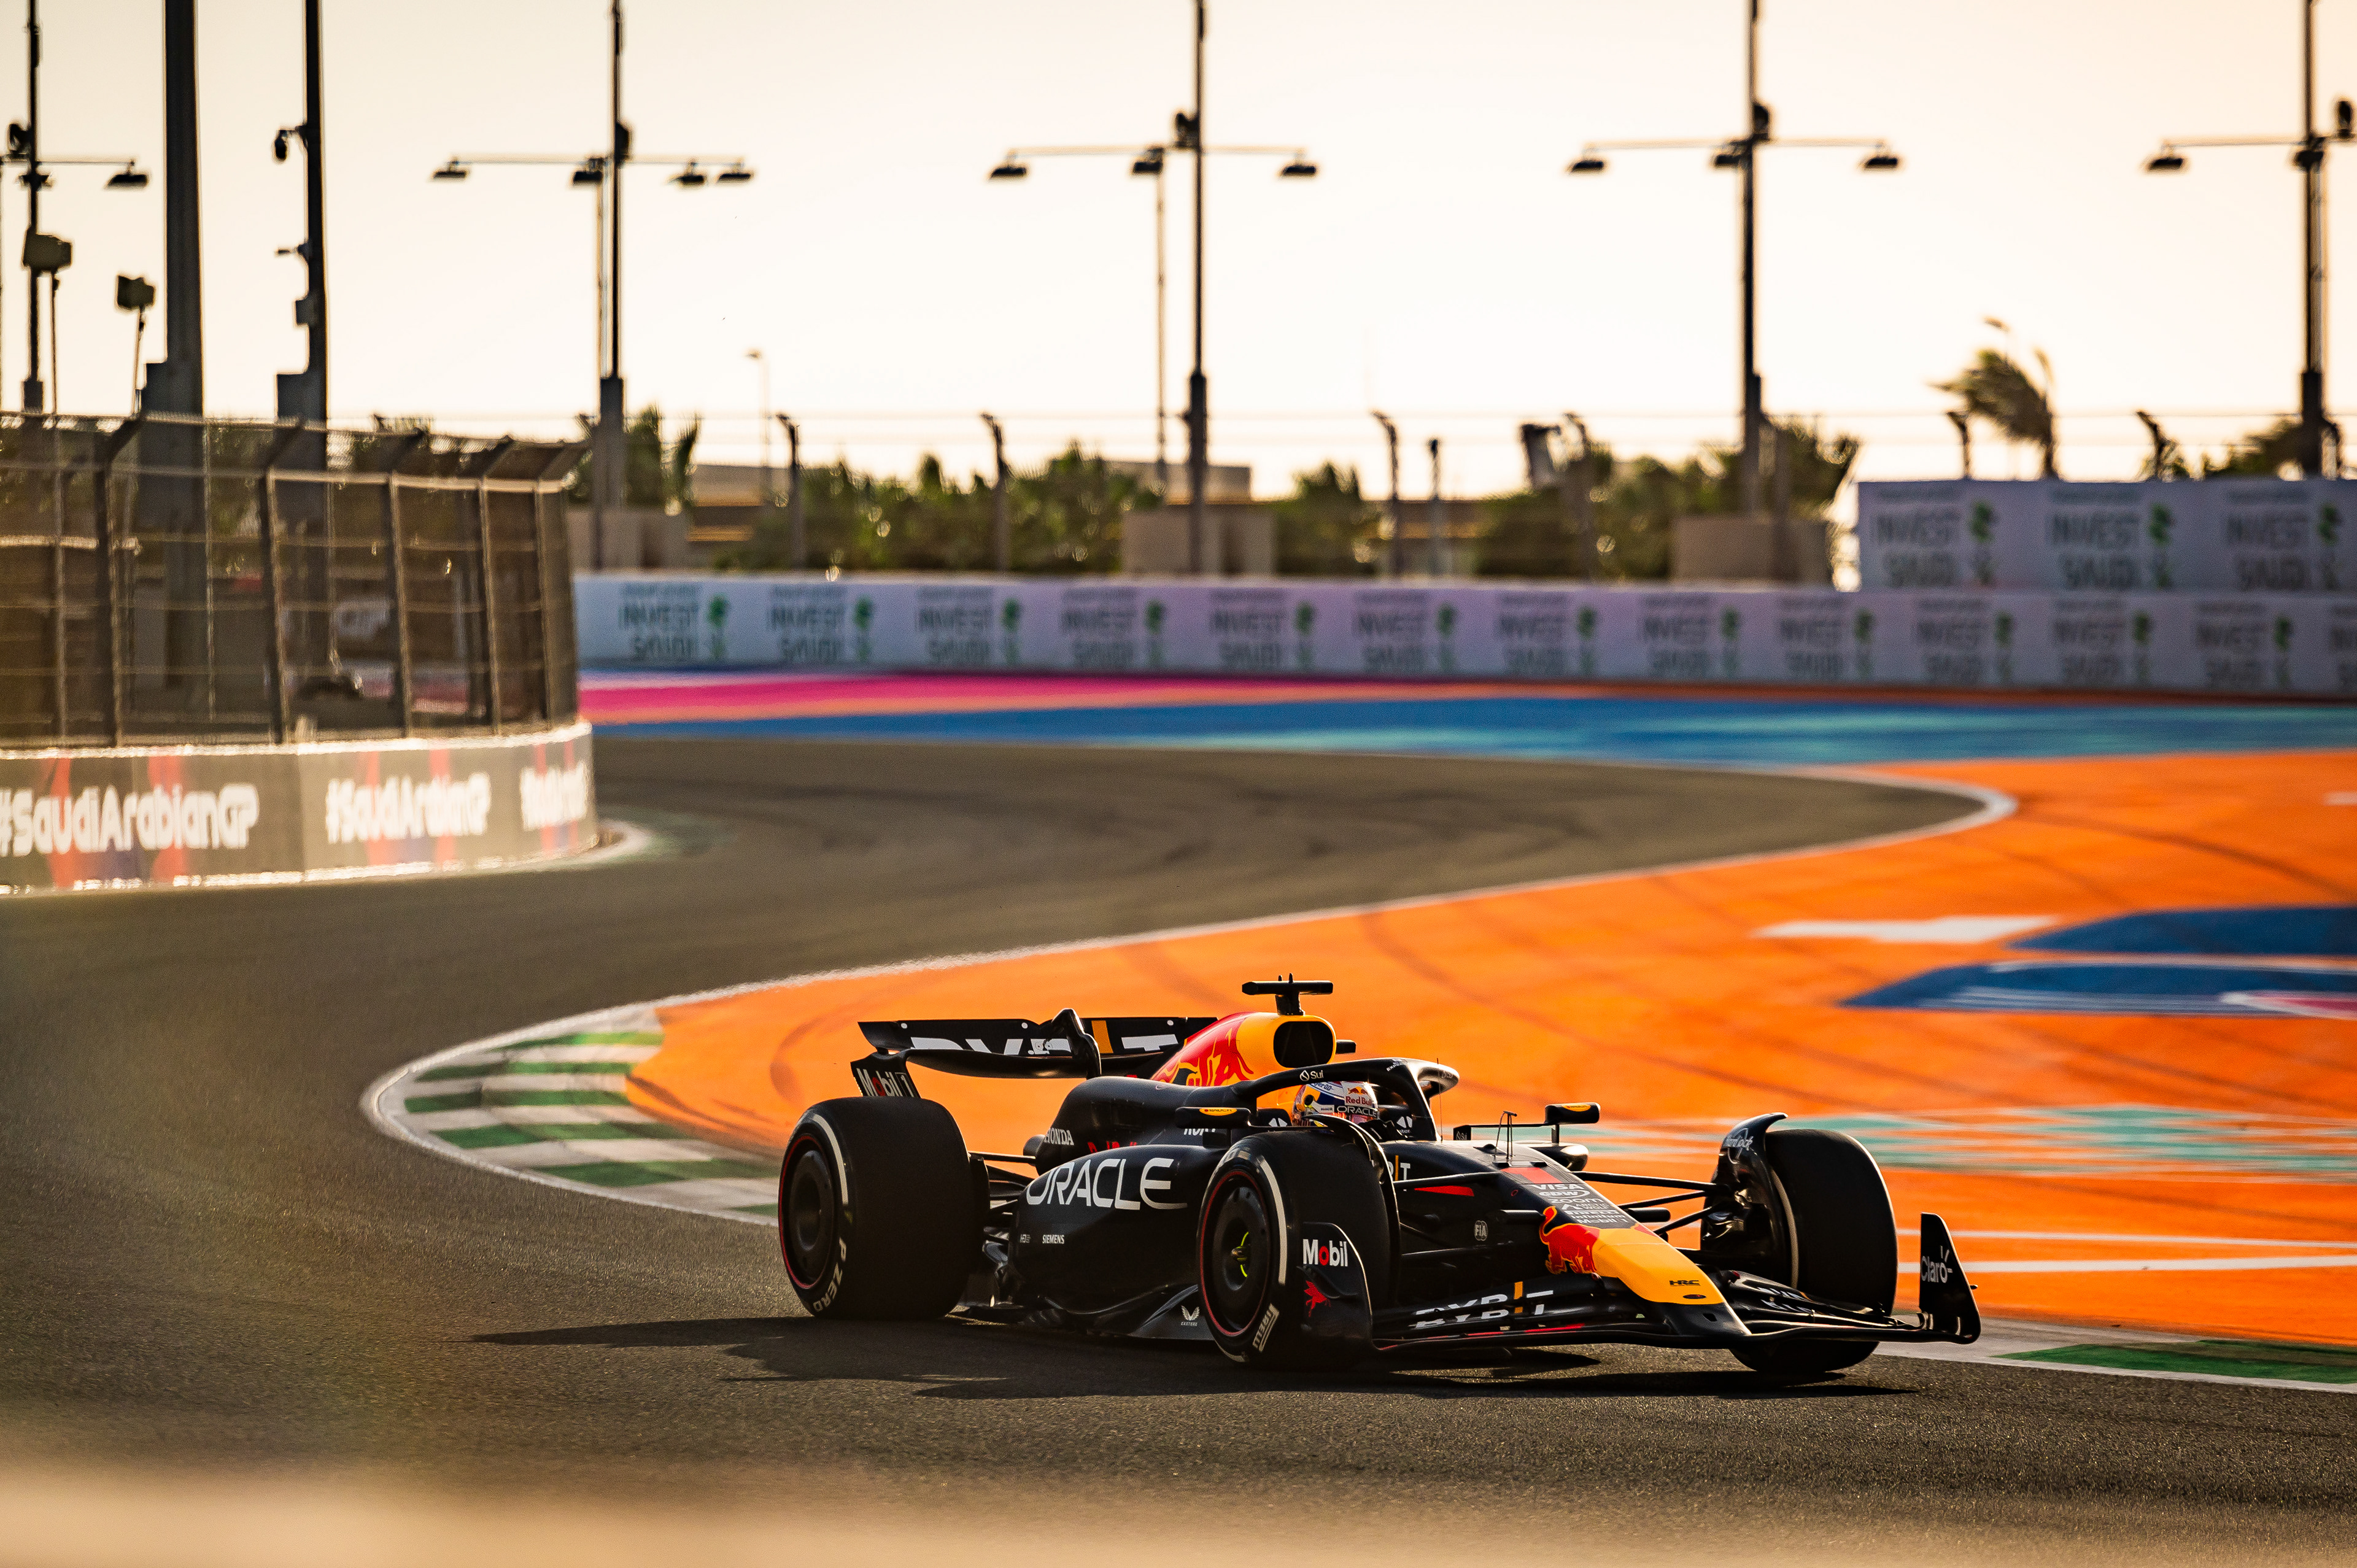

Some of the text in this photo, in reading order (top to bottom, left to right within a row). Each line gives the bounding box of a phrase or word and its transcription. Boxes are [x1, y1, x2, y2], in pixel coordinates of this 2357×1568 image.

[856, 1068, 904, 1097] Mobil
[1310, 1070, 1324, 1079] Sui
[1337, 1105, 1377, 1117] ORACLE
[1043, 1127, 1074, 1146] HONDA
[1026, 1157, 1188, 1210] ORACLE
[1042, 1234, 1064, 1244] SIEMENS
[1302, 1238, 1348, 1267] Mobil
[1921, 1256, 1948, 1283] Claro
